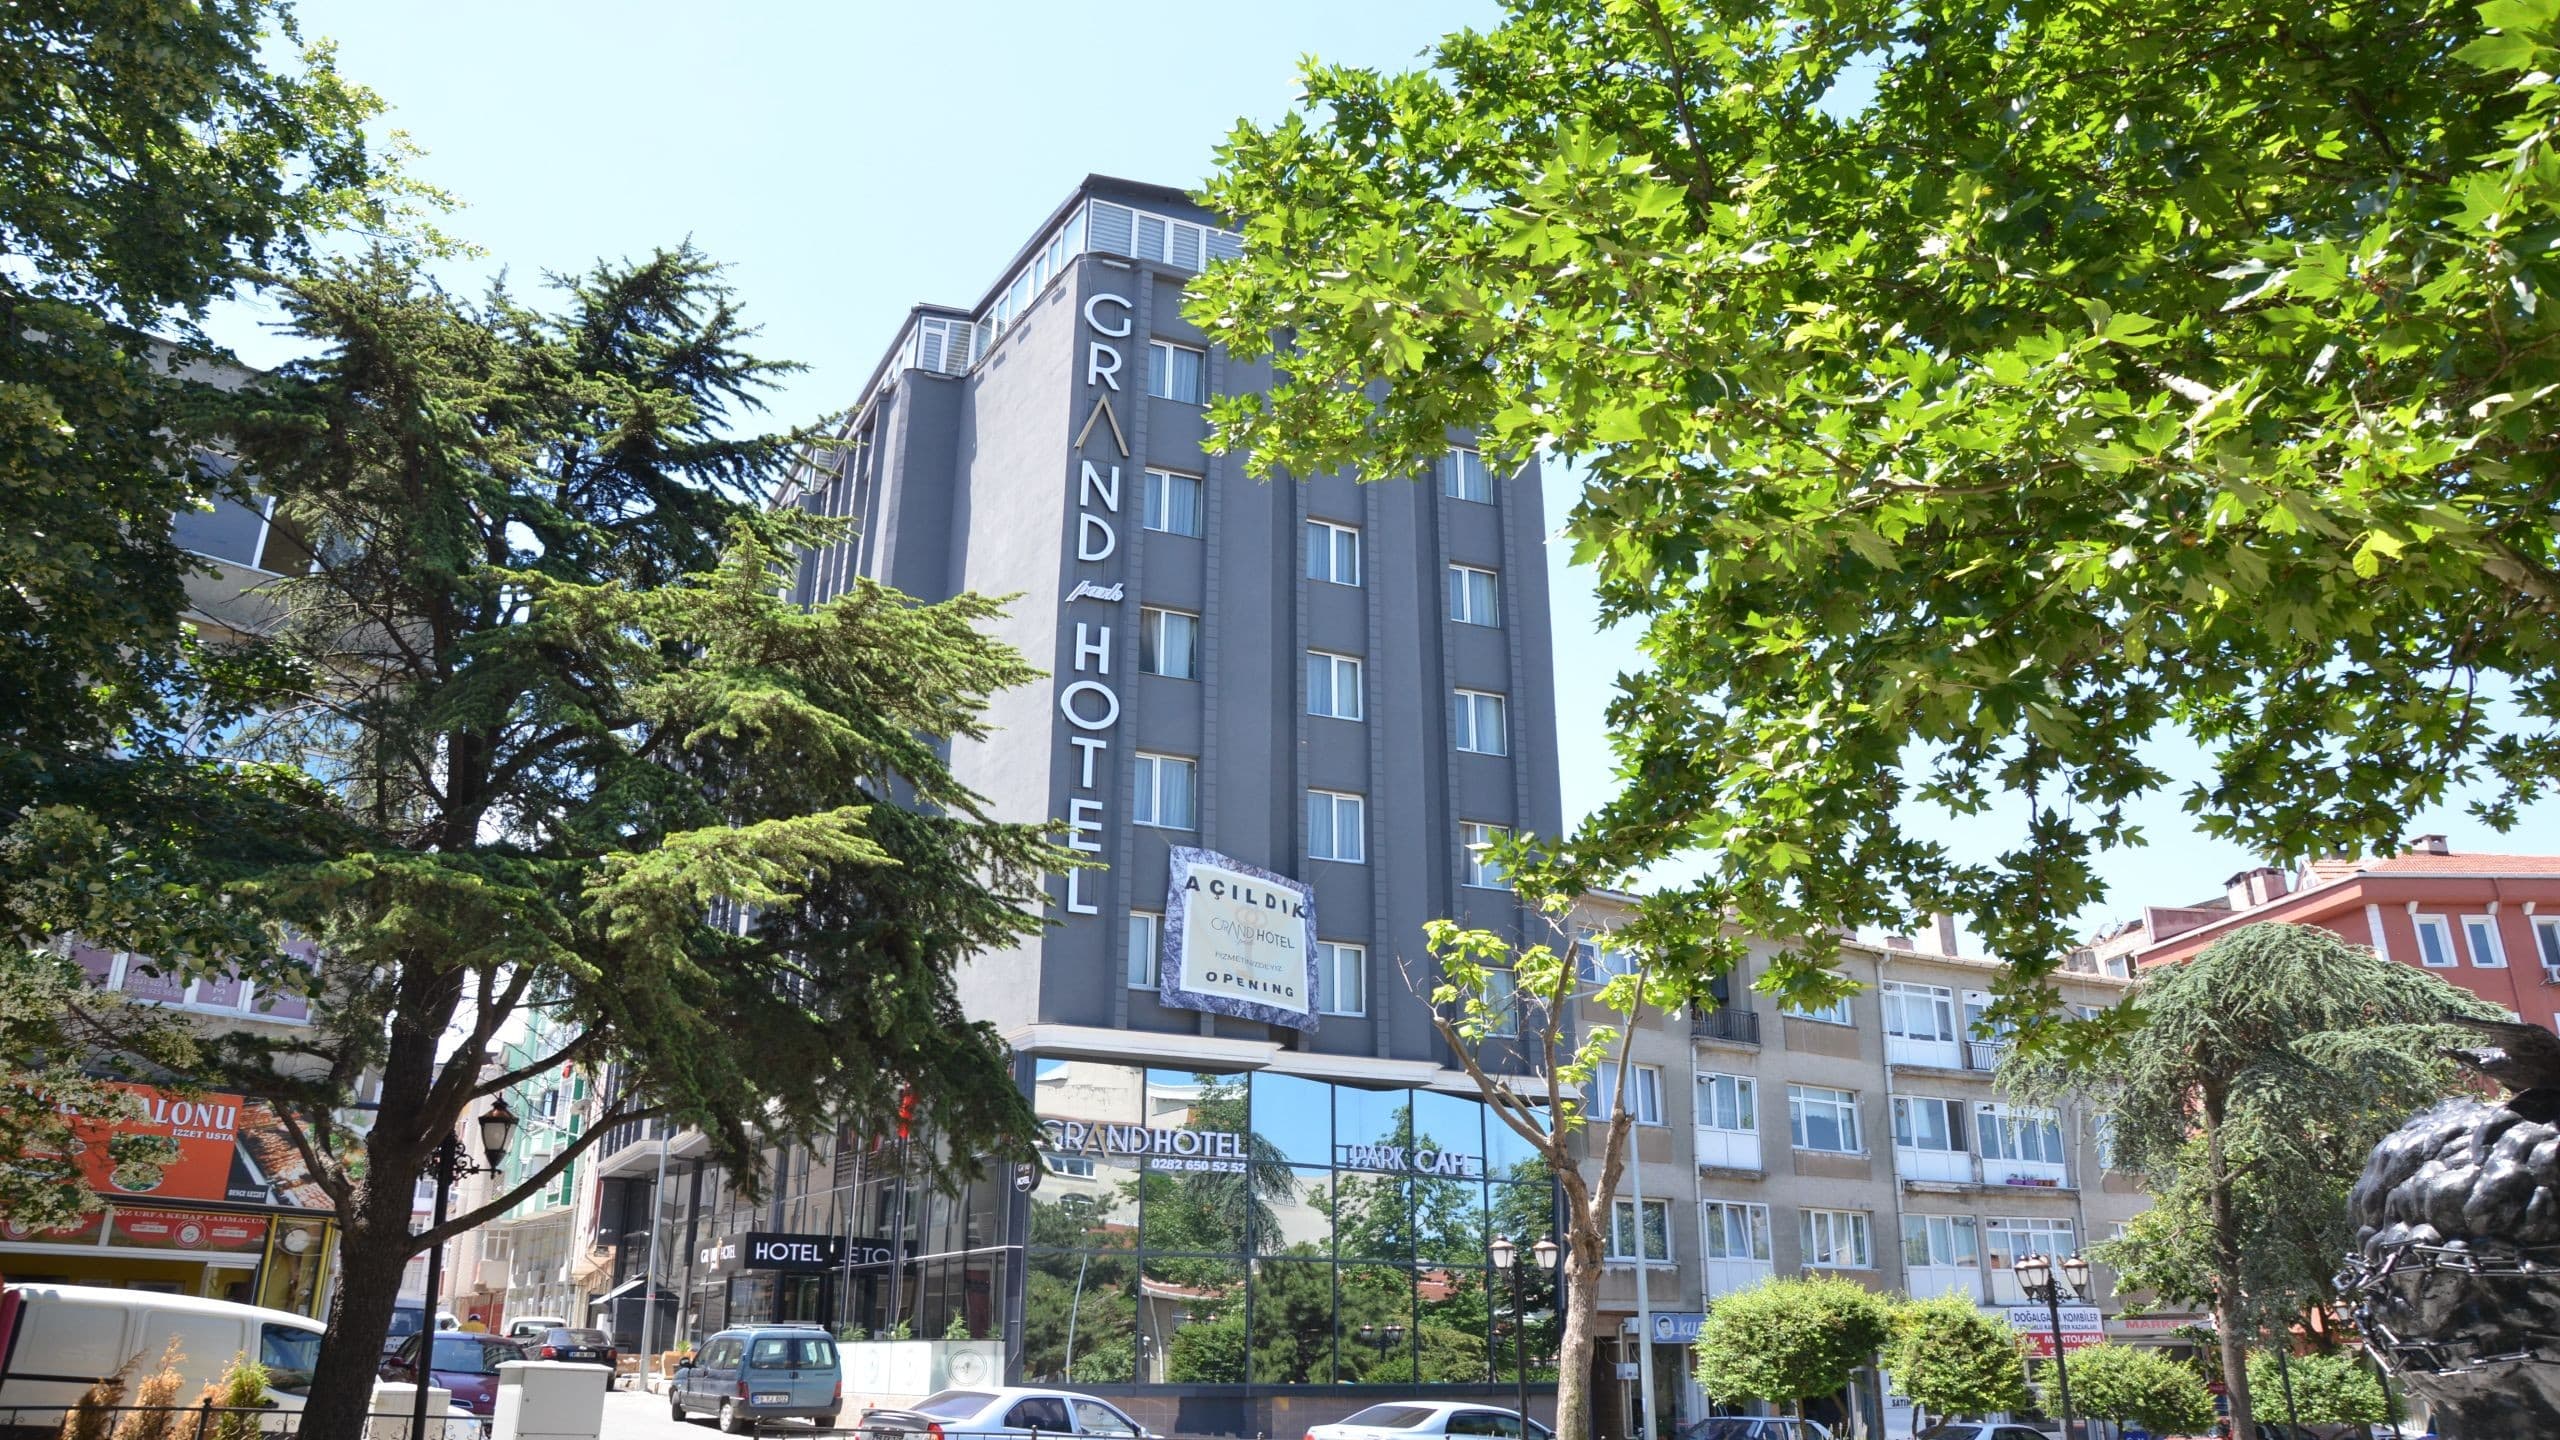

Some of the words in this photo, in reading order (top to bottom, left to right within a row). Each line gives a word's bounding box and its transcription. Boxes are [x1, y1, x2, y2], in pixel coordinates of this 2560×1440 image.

[1073, 293, 1133, 562] GRAND
[1060, 622, 1120, 915] HOTEL
[1185, 875, 1307, 920] AÇILDIK
[1256, 928, 1296, 949] HOTEL
[1206, 971, 1294, 998] OPENING
[206, 1131, 235, 1142] USTA
[1040, 1119, 1151, 1158] GRAND
[1153, 1128, 1248, 1159] HOTEL
[1151, 1159, 1183, 1171] 0282
[1185, 1160, 1209, 1172] 650
[1211, 1161, 1228, 1172] 52
[1229, 1162, 1247, 1173] 52
[1350, 1144, 1410, 1171] PARK
[166, 1212, 205, 1222] KEBAP
[205, 1215, 268, 1225] LAHMACUN
[755, 1241, 823, 1262] HOTEL
[2043, 1335, 2103, 1346] MNTOLAMA
